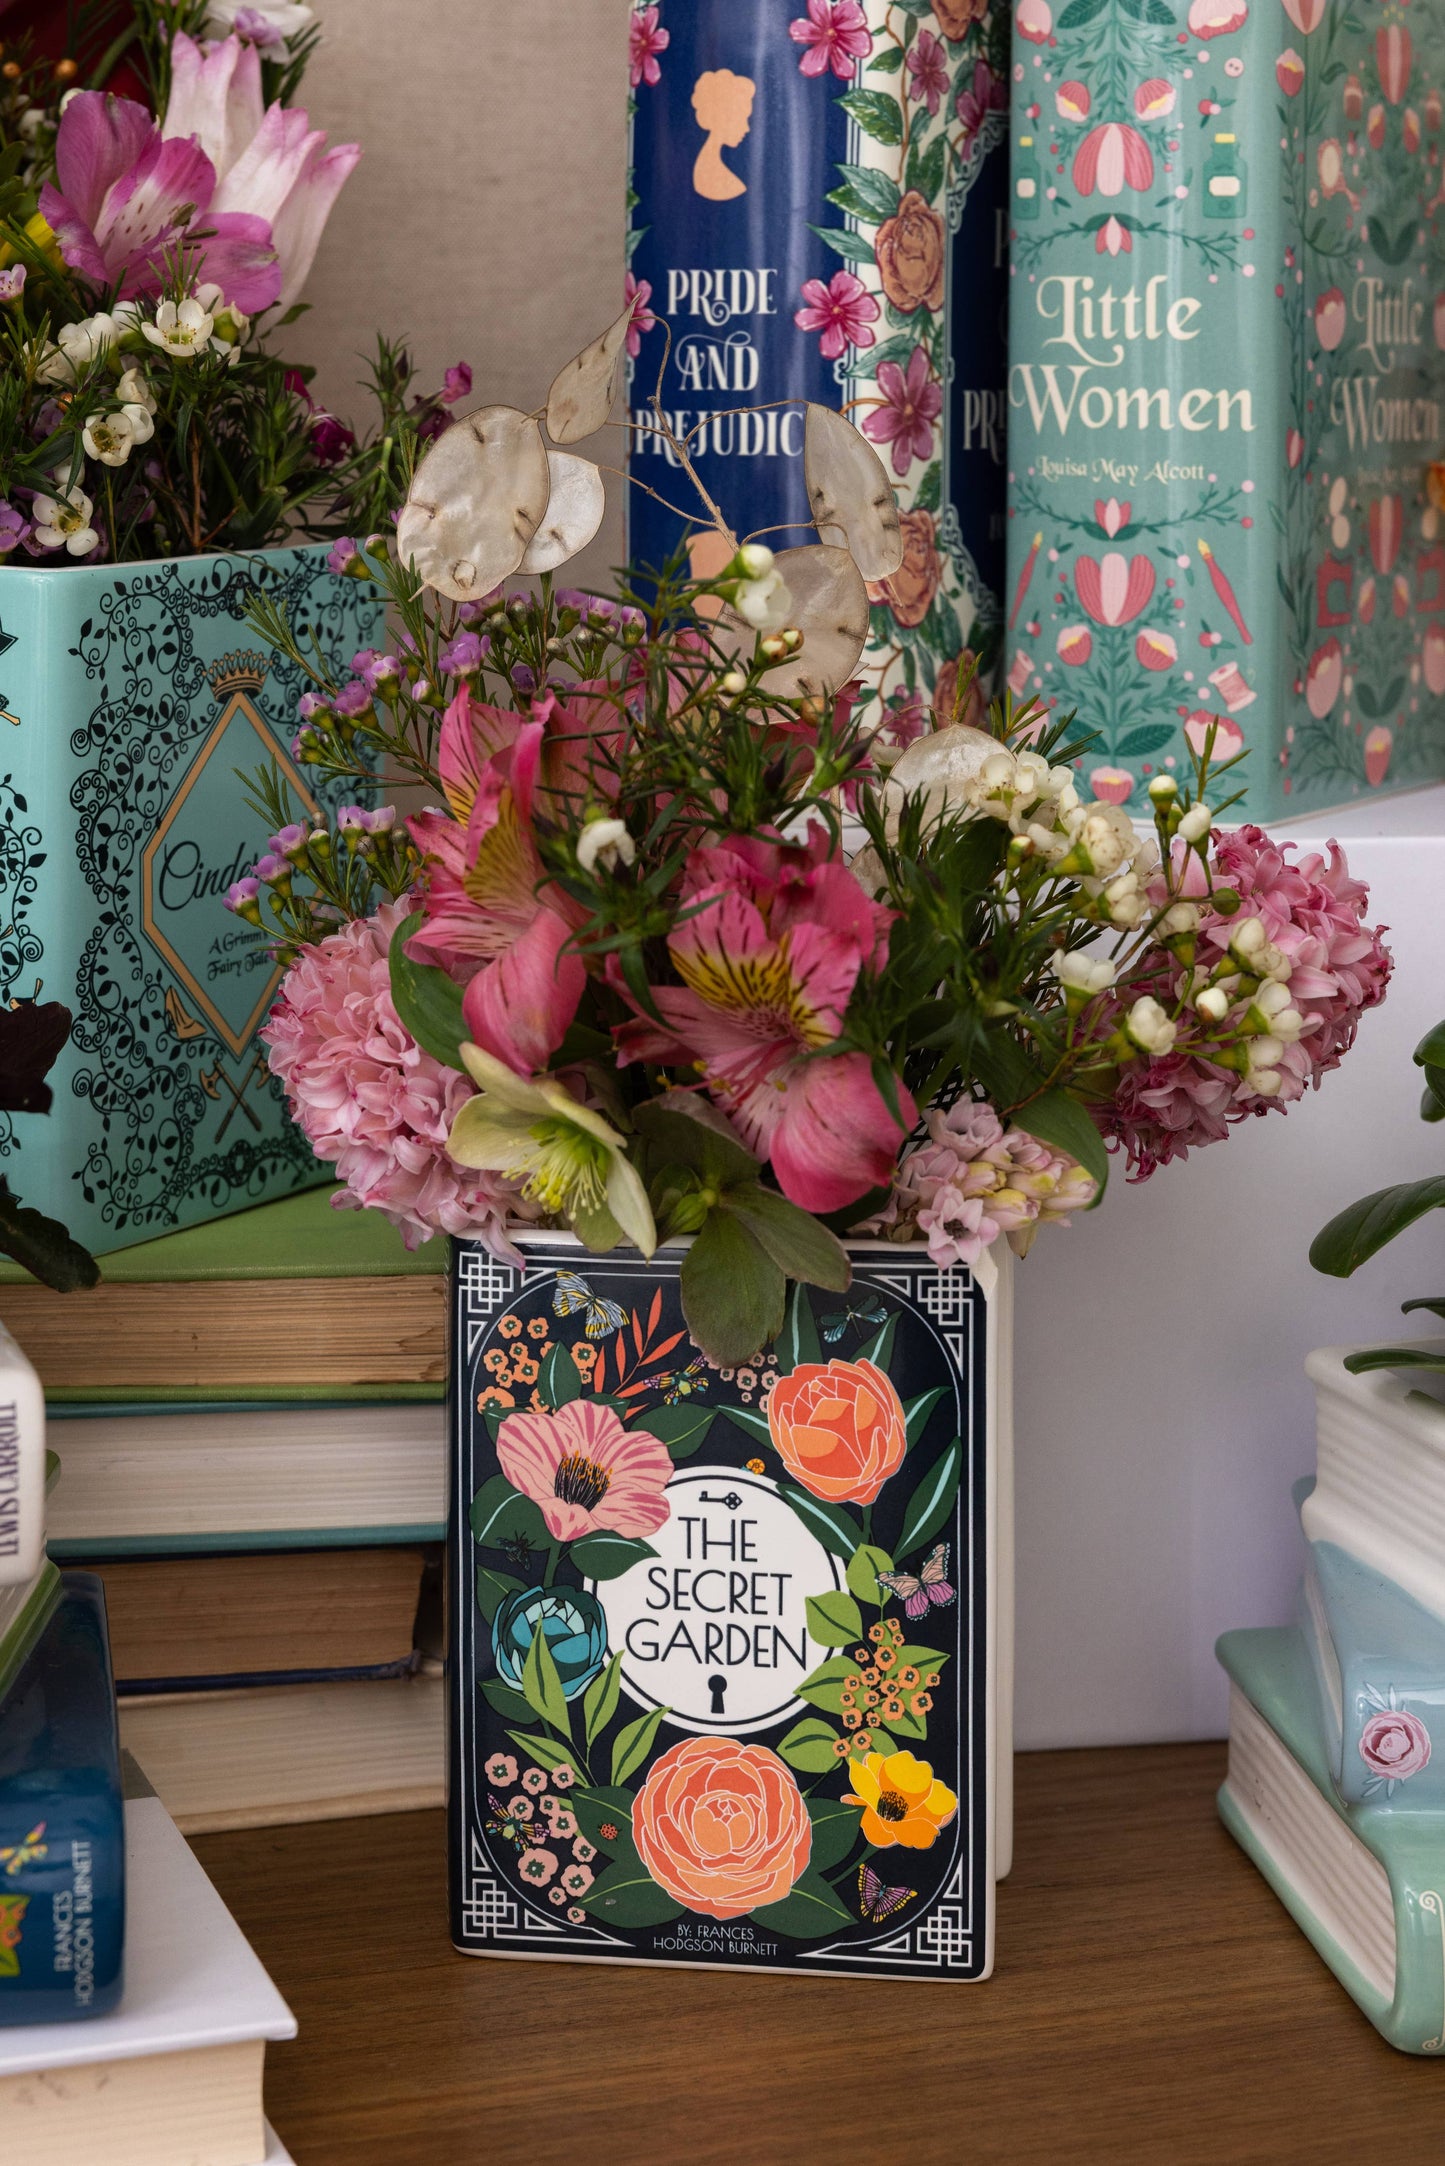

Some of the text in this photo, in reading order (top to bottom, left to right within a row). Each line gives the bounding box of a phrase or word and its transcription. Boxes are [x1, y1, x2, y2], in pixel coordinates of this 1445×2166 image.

[667, 268, 777, 326] PRIDE
[1036, 274, 1202, 367] Little
[1352, 277, 1424, 374] Little
[675, 331, 759, 392] AND
[1008, 363, 1257, 436] Women
[1330, 376, 1439, 450] Women
[635, 410, 804, 468] PREJUDIC
[1035, 456, 1204, 487] Louisa May Alcott
[207, 958, 242, 981] Fairy
[209, 937, 222, 954] A
[677, 1516, 758, 1563] THE
[646, 1566, 793, 1616] SECRET
[625, 1618, 807, 1671] GARDEN
[653, 1937, 778, 1957] HODGSON BURNETT
[677, 1924, 755, 1941] BY: FRANCES
